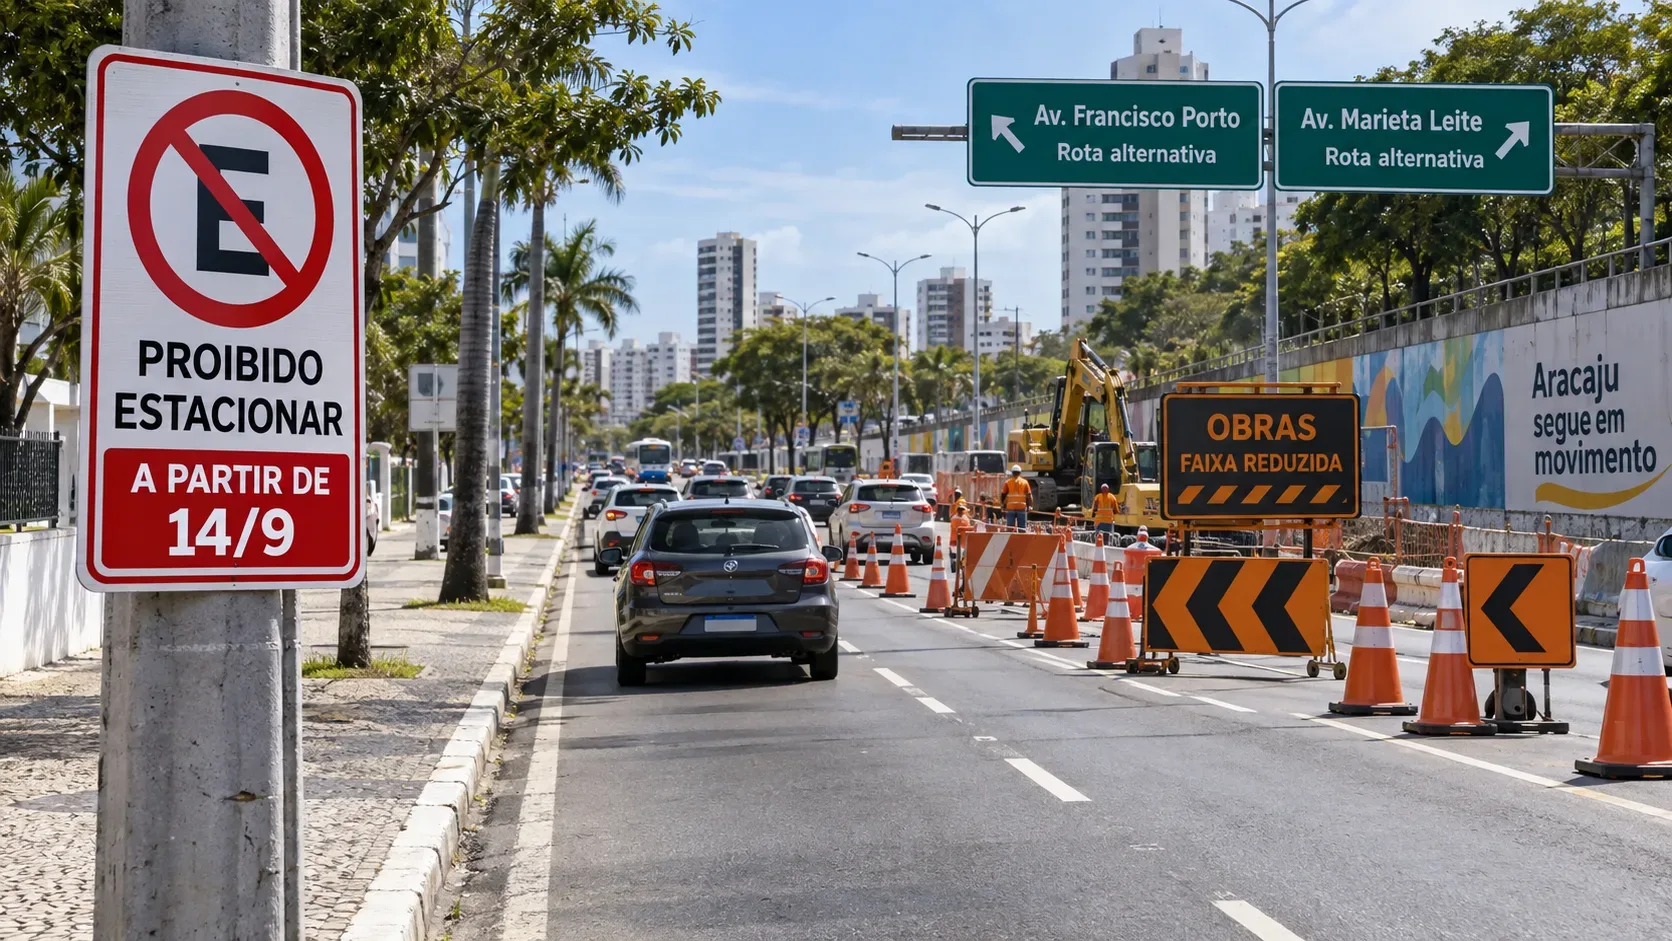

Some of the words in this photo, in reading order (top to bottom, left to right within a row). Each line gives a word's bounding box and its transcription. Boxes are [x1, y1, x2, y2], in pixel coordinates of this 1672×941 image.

[1034, 104, 1067, 126] Av.
[1074, 104, 1175, 128] Francisco
[1182, 106, 1240, 129] Porto
[1300, 107, 1334, 130] Av.
[1341, 108, 1422, 131] Marieta
[1430, 109, 1483, 132] Leite
[1057, 142, 1103, 162] Rota
[1110, 143, 1216, 164] alternativa
[1325, 147, 1371, 166] Rota
[1378, 147, 1484, 169] alternativa
[196, 143, 270, 277] E
[138, 339, 323, 386] PROIBIDO
[1531, 353, 1619, 404] Aracaju
[114, 392, 343, 437] ESTACIONAR
[1207, 413, 1316, 441] OBRAS
[1533, 410, 1592, 445] segue
[1595, 408, 1625, 434] em
[1180, 453, 1238, 472] FAIXA
[1244, 453, 1343, 472] REDUZIDA
[1535, 439, 1657, 475] movimento
[130, 462, 157, 493] A
[167, 463, 283, 495] PARTIR
[293, 466, 330, 496] DE
[168, 507, 295, 558] 14/9
